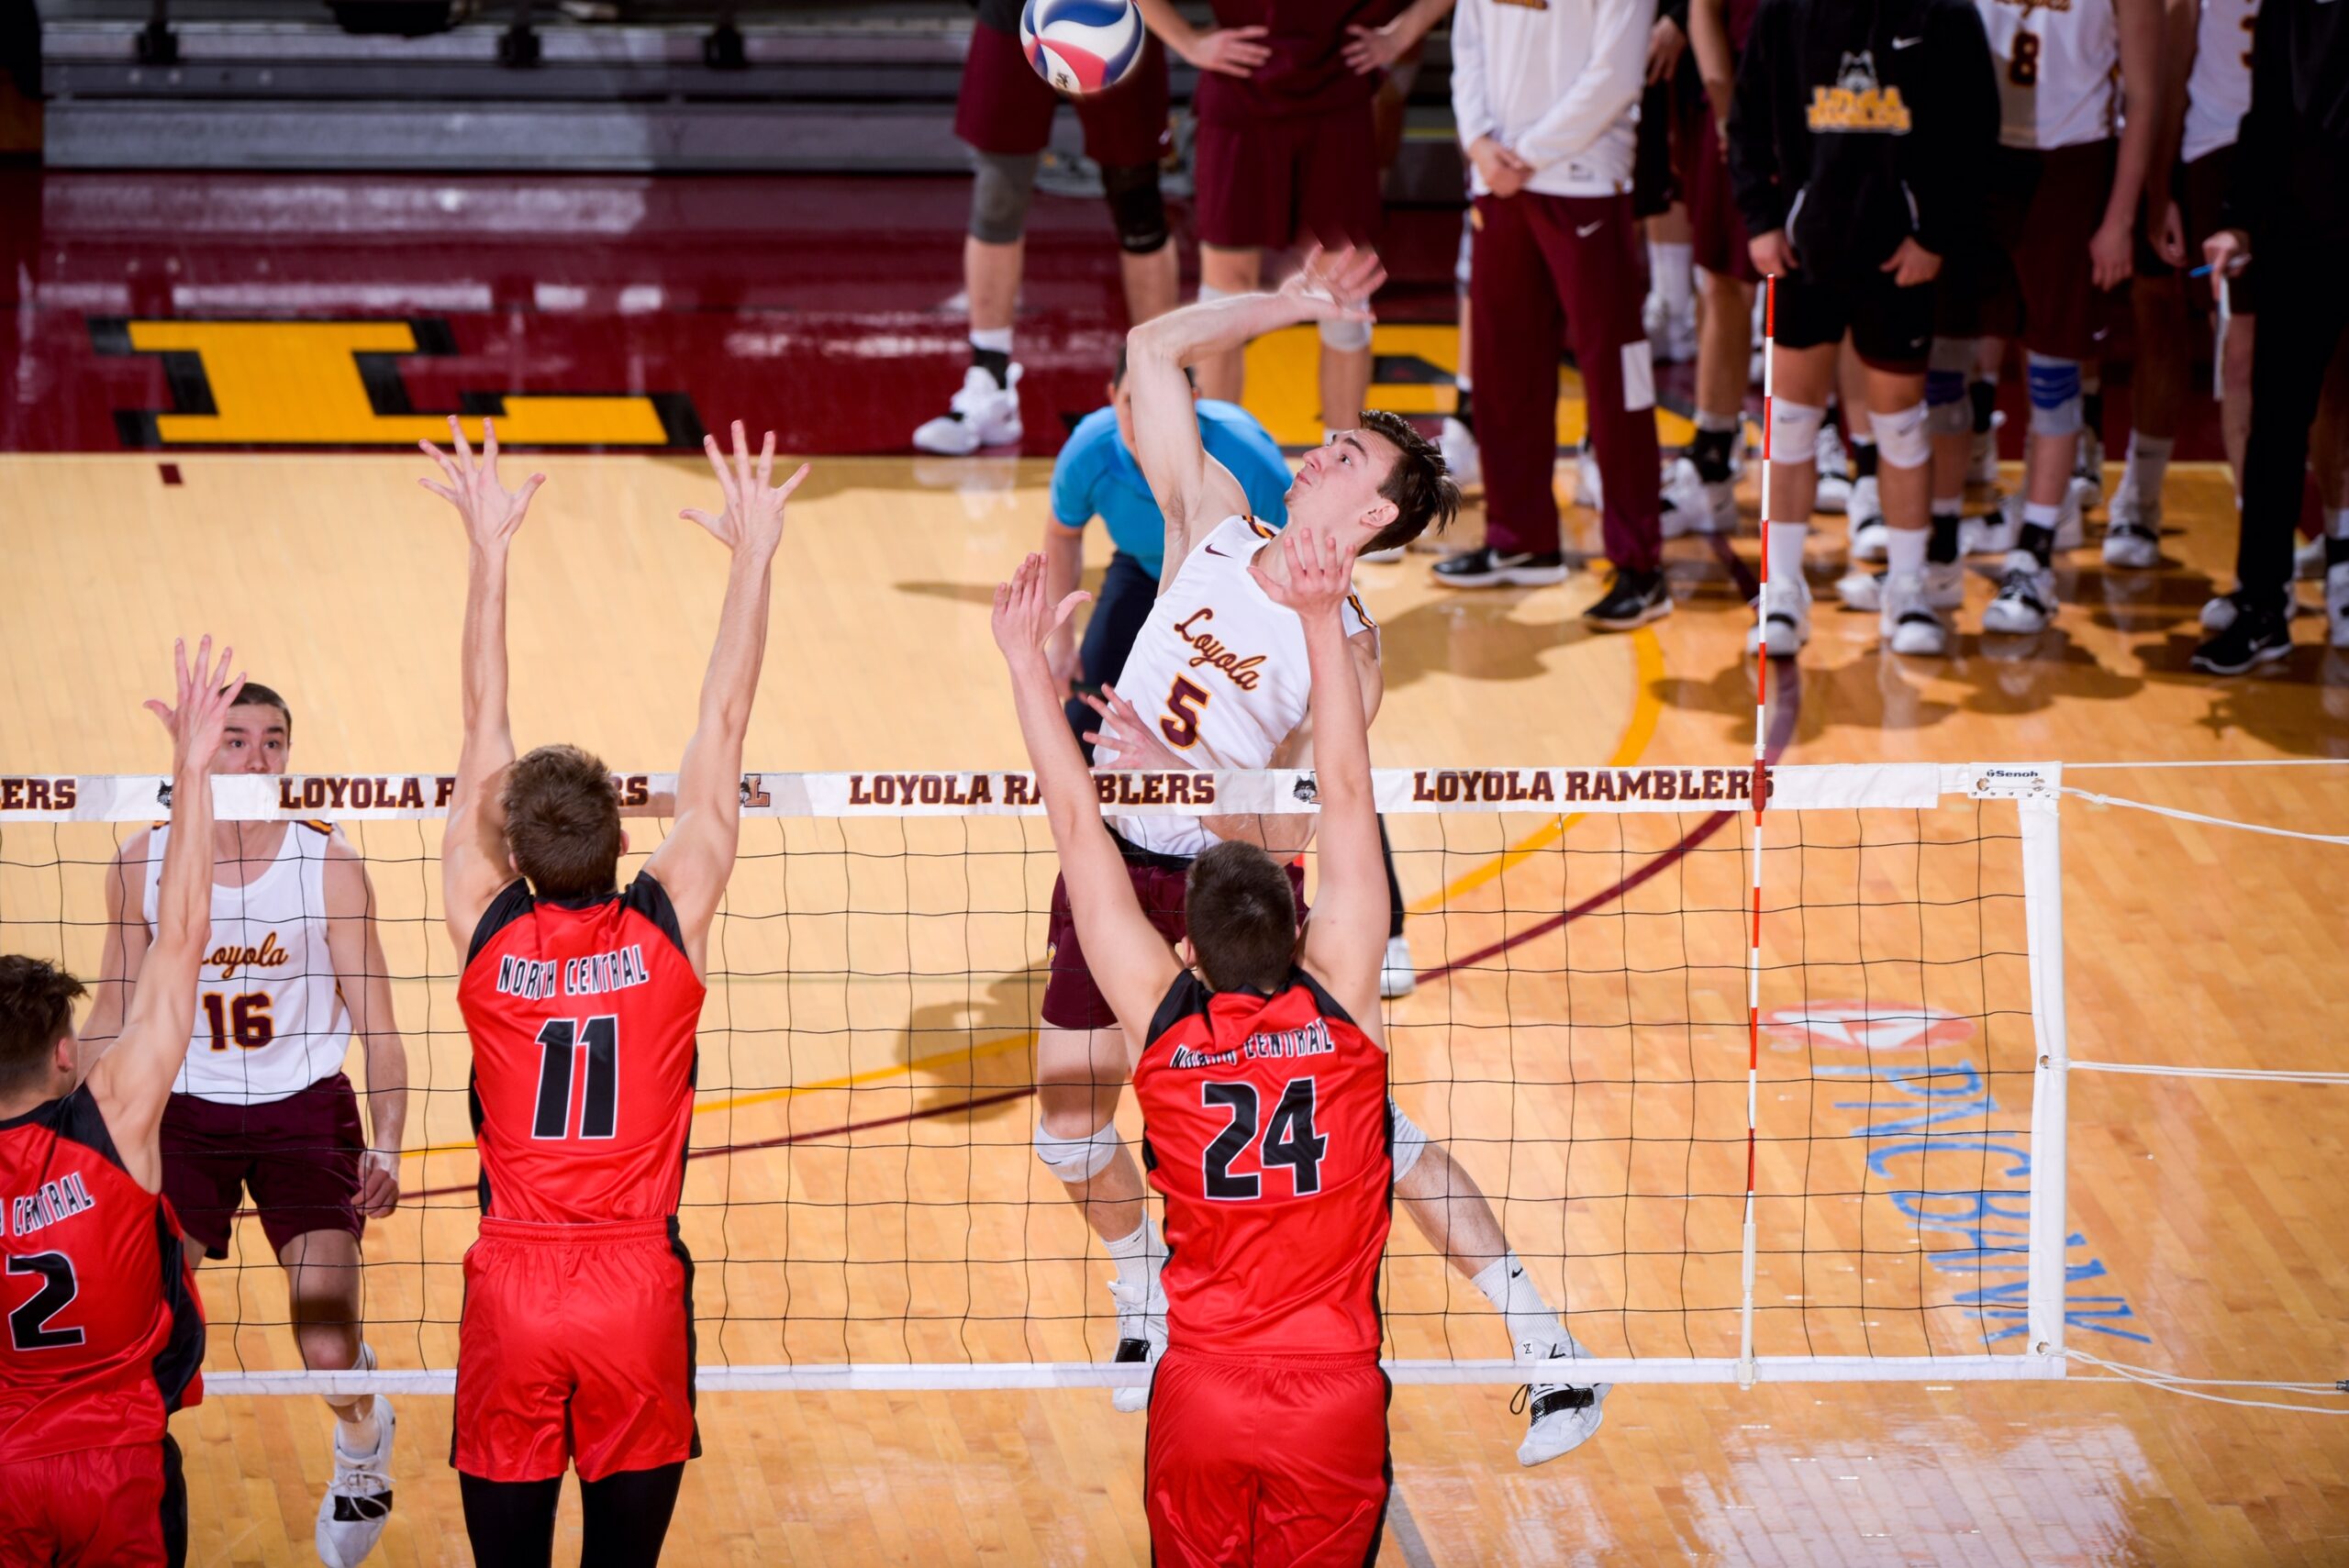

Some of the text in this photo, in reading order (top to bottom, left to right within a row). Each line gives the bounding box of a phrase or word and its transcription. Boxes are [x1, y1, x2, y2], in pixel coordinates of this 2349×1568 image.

[2009, 31, 2039, 85] 8
[1174, 607, 1266, 691] Loyola
[1160, 673, 1211, 751] 5
[279, 777, 425, 809] LOYOLA
[849, 773, 1216, 806] LOYOLA RBLERS
[1412, 771, 1554, 802] LOYOLA
[1995, 770, 2039, 778] Senoh
[201, 931, 289, 980] oyola
[496, 944, 650, 1000] NORTH CENTRAL
[202, 991, 274, 1052] 16
[1243, 1018, 1335, 1060] CENTRAL
[530, 1013, 618, 1140] 11
[1202, 1075, 1330, 1200] 24
[13, 1171, 96, 1237] CENTRAL
[6, 1250, 86, 1351] 2
